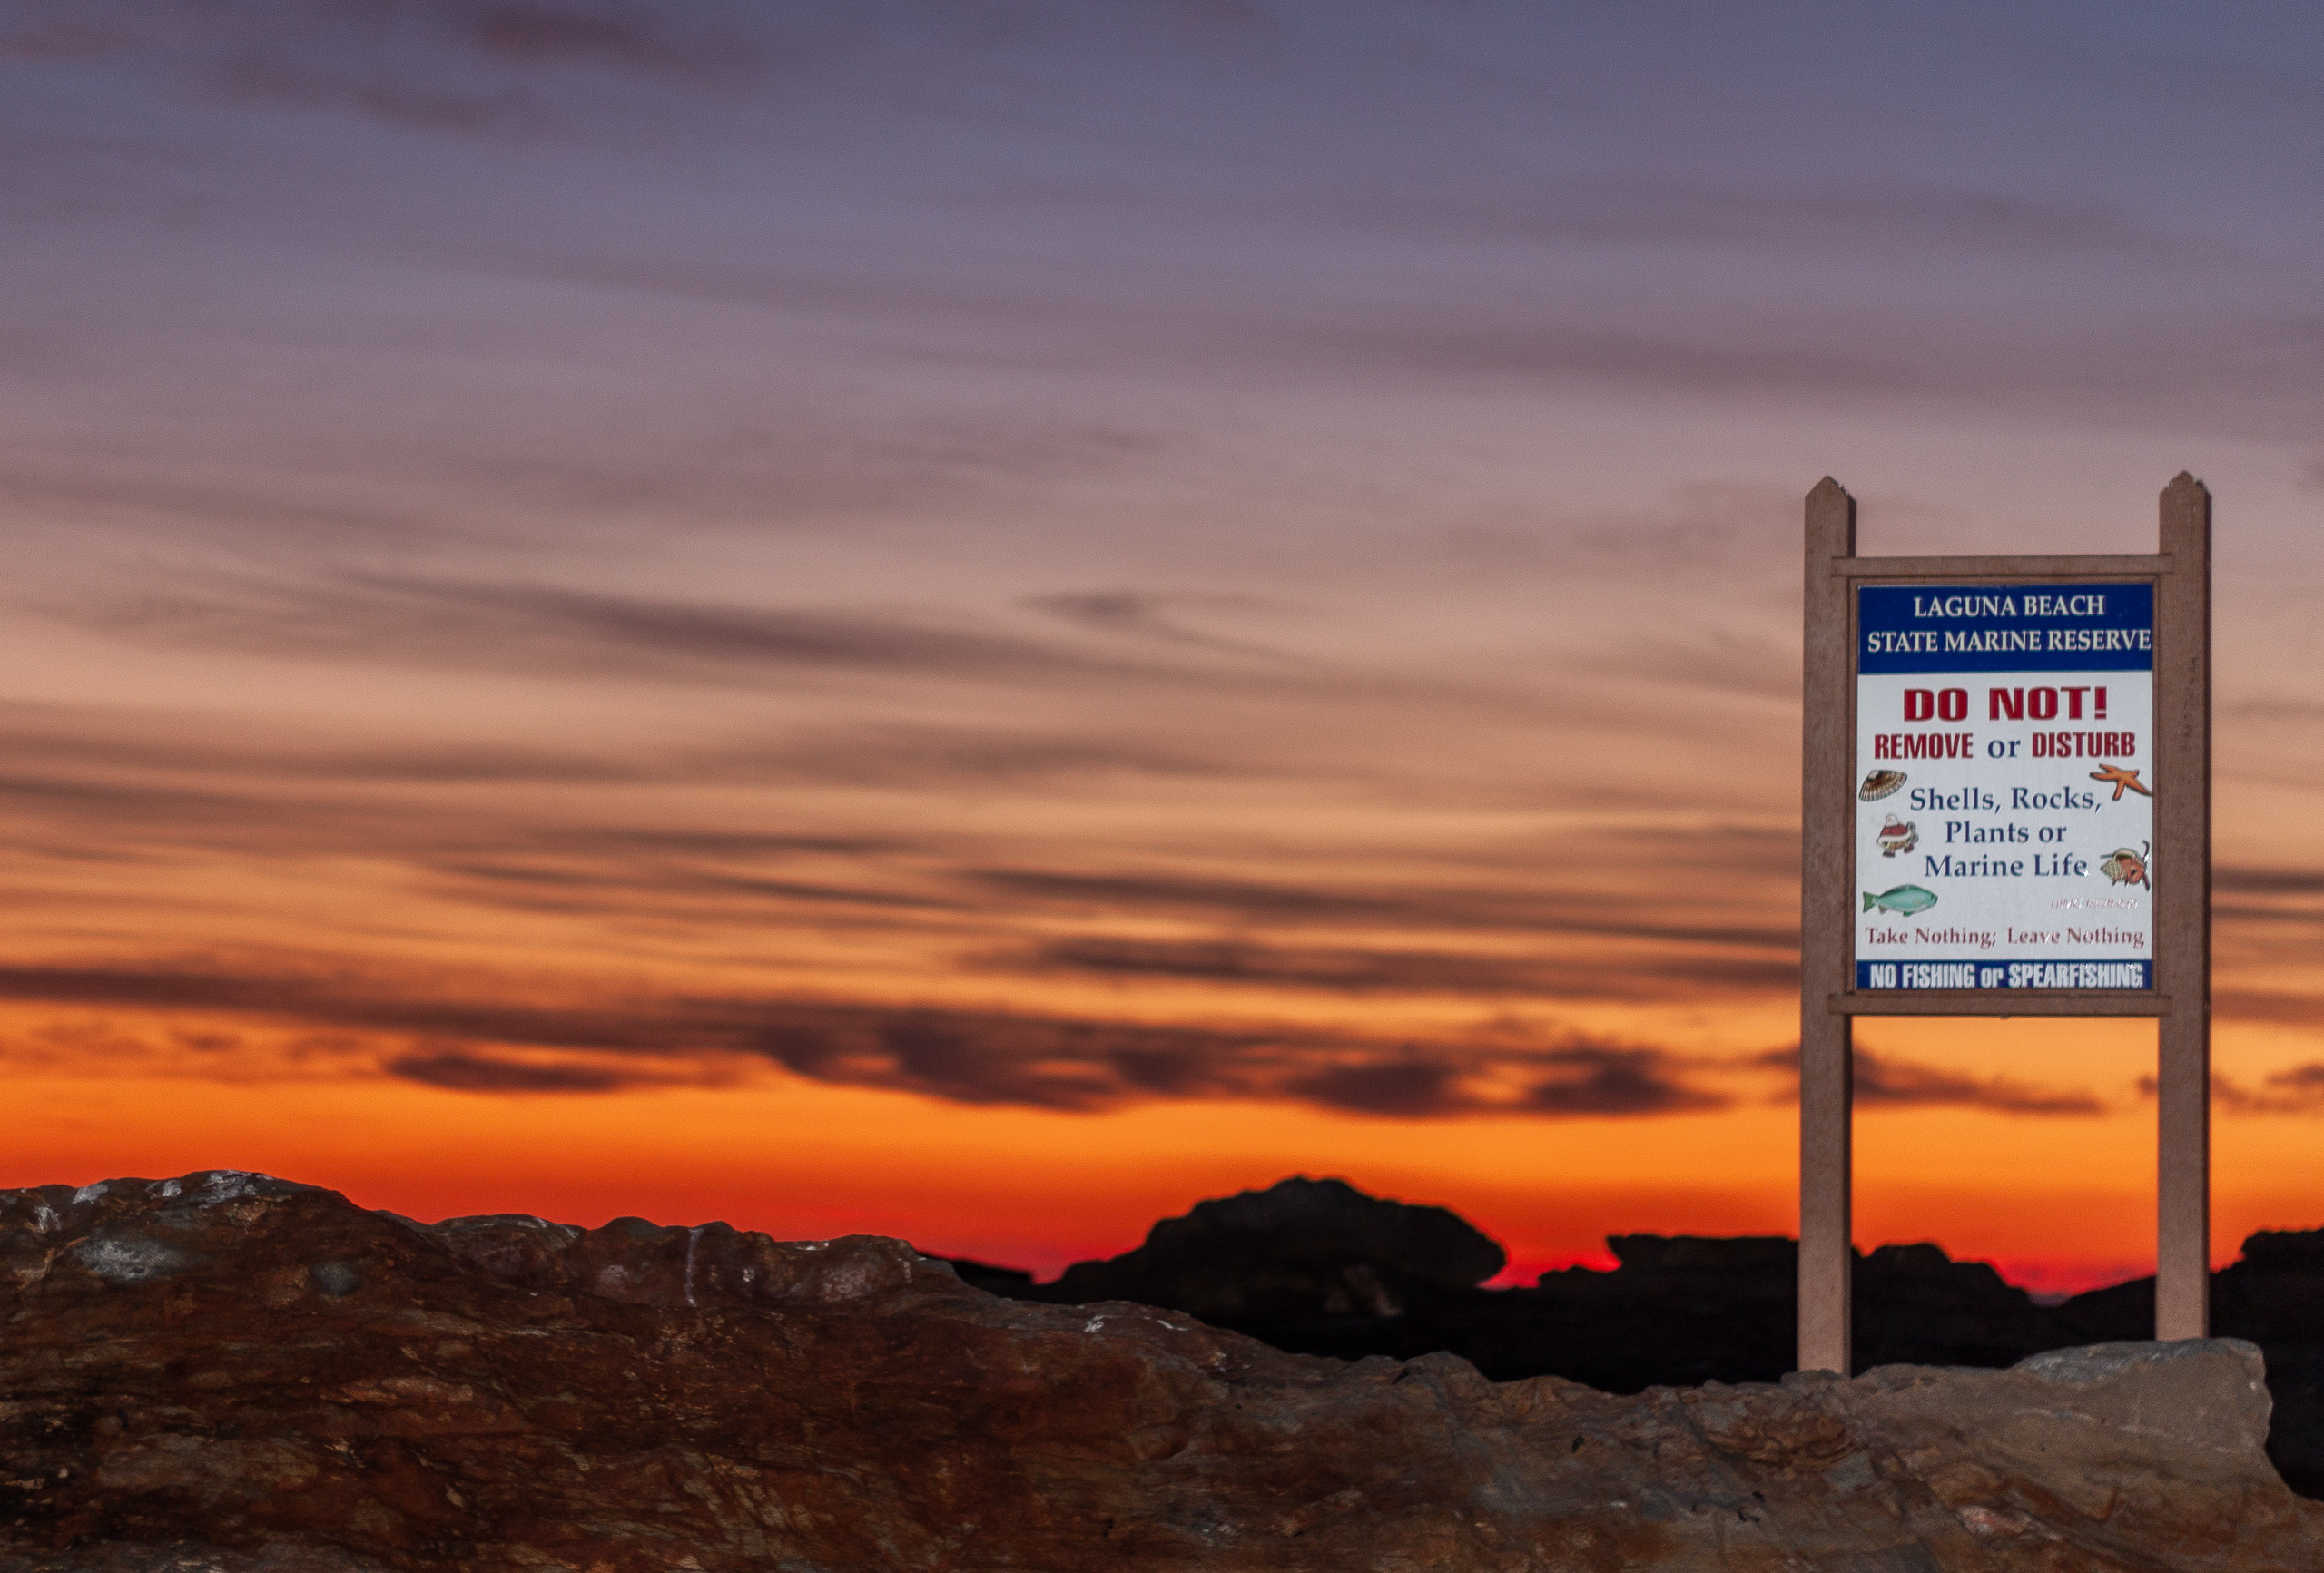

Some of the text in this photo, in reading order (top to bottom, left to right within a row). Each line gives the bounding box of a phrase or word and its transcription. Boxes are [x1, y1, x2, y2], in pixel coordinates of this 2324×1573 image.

[1914, 595, 2105, 618] LAGUNA BEACH
[1868, 629, 2152, 653] STATE MARINE RESERVE
[1904, 686, 2107, 722] DO NOT!
[1875, 732, 2135, 759] REMOVE or DISTURB
[1910, 786, 2102, 814] Shells, Rocks,
[1945, 821, 2067, 844] Plants or
[1925, 852, 2090, 877] Marine Life
[1866, 927, 1908, 944] Take
[2007, 927, 2060, 944] Leave
[2066, 927, 2144, 949] Nothing
[1870, 962, 2143, 988] NO FISHING or SPEARFISHING
